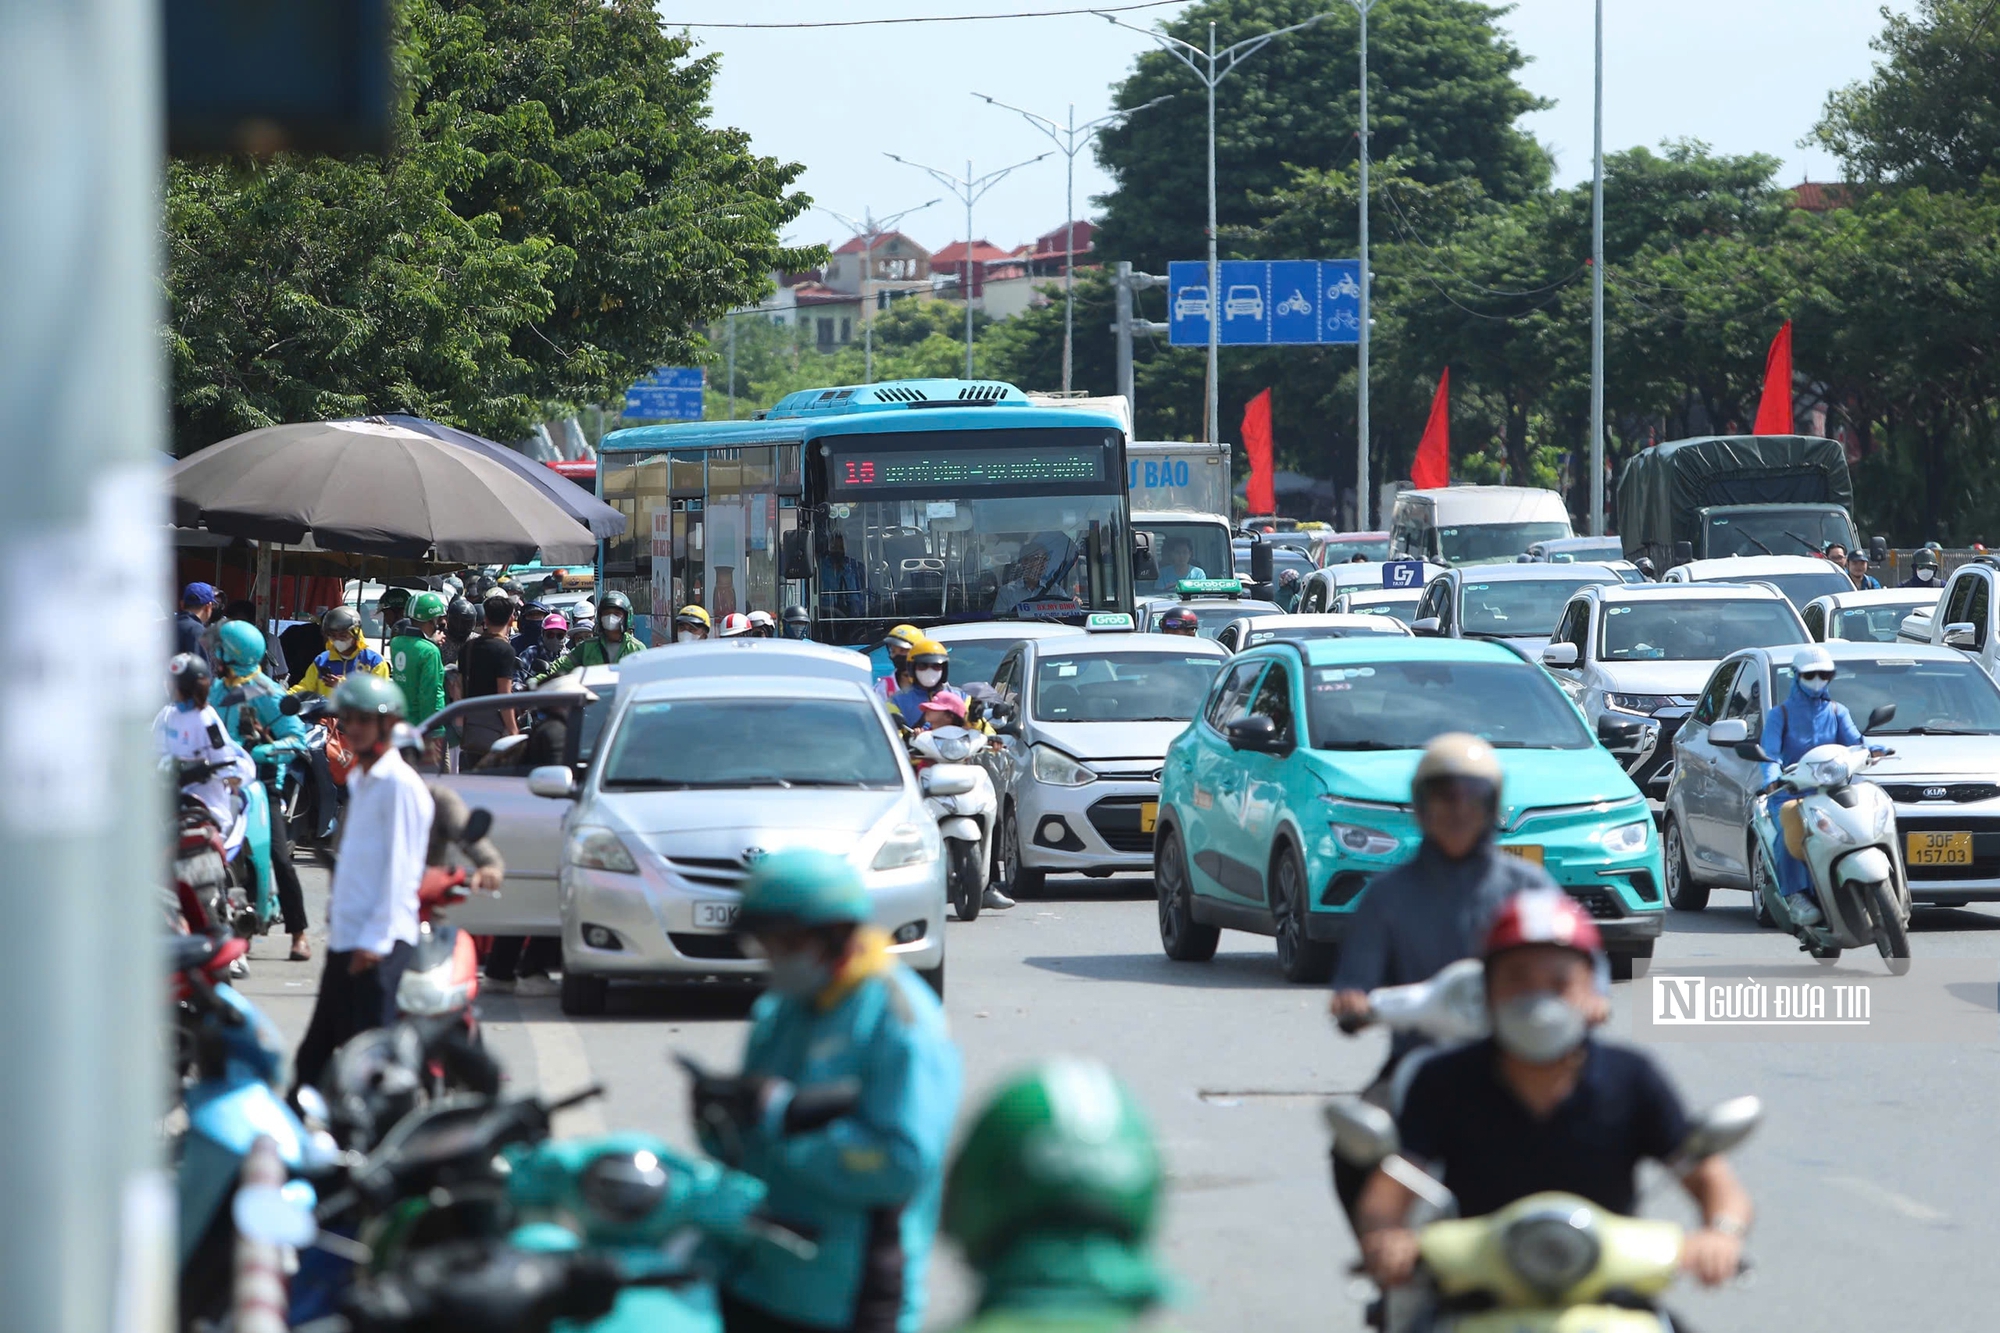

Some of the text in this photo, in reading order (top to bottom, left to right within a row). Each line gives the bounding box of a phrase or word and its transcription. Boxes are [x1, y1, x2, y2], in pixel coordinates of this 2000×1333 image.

[1144, 456, 1189, 488] BÁO
[1394, 565, 1414, 586] G7
[1018, 603, 1031, 612] 16
[1096, 615, 1126, 624] Grab
[1926, 788, 1945, 796] KIA
[1926, 834, 1953, 848] 30F
[1916, 849, 1966, 863] 157.03
